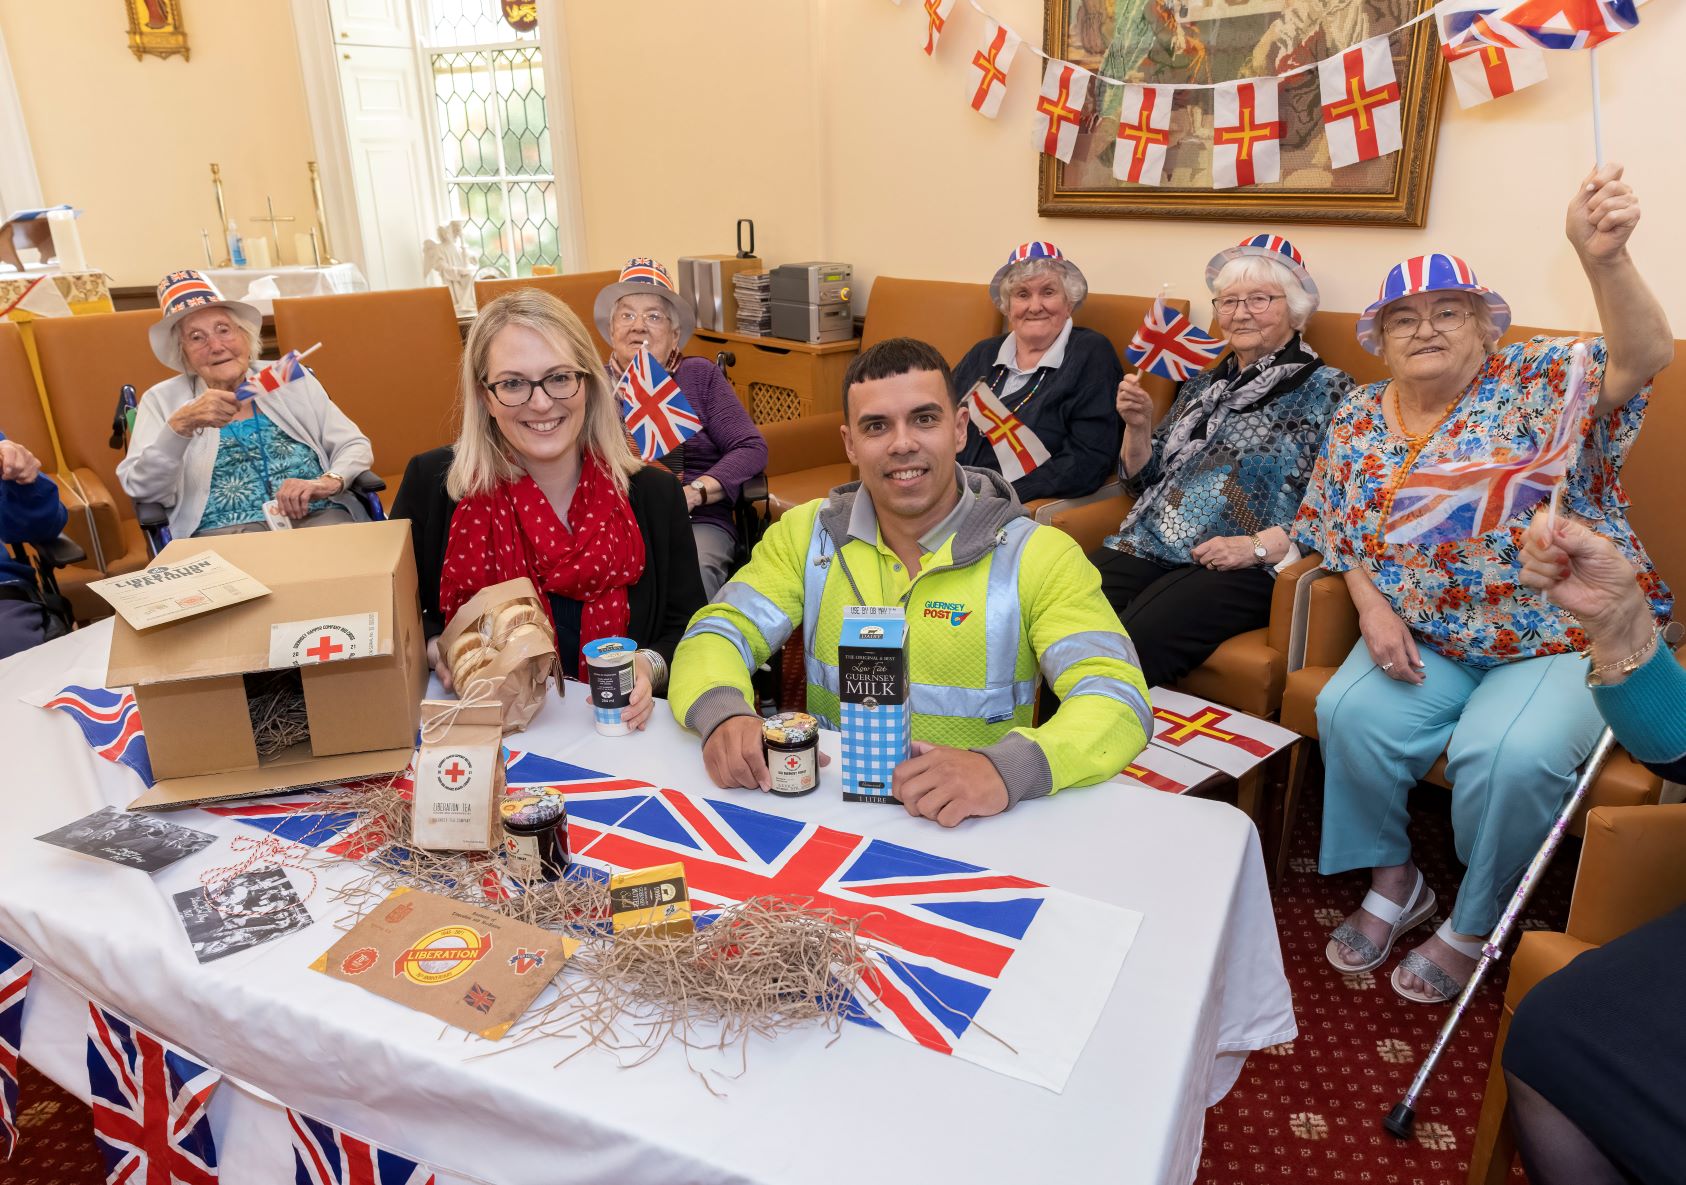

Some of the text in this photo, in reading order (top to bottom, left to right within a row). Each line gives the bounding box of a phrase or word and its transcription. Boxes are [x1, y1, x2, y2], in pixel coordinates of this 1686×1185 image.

[115, 560, 211, 588] LIBERATION
[850, 607, 860, 615] USE
[862, 607, 869, 615] BY
[924, 601, 966, 611] GUERNSEY
[923, 608, 951, 619] POST
[852, 661, 871, 672] Low
[845, 673, 896, 682] GUERNSEY
[845, 681, 897, 696] MILK
[432, 802, 472, 812] LIBERATION TEA
[407, 950, 479, 960] LIBERATION
